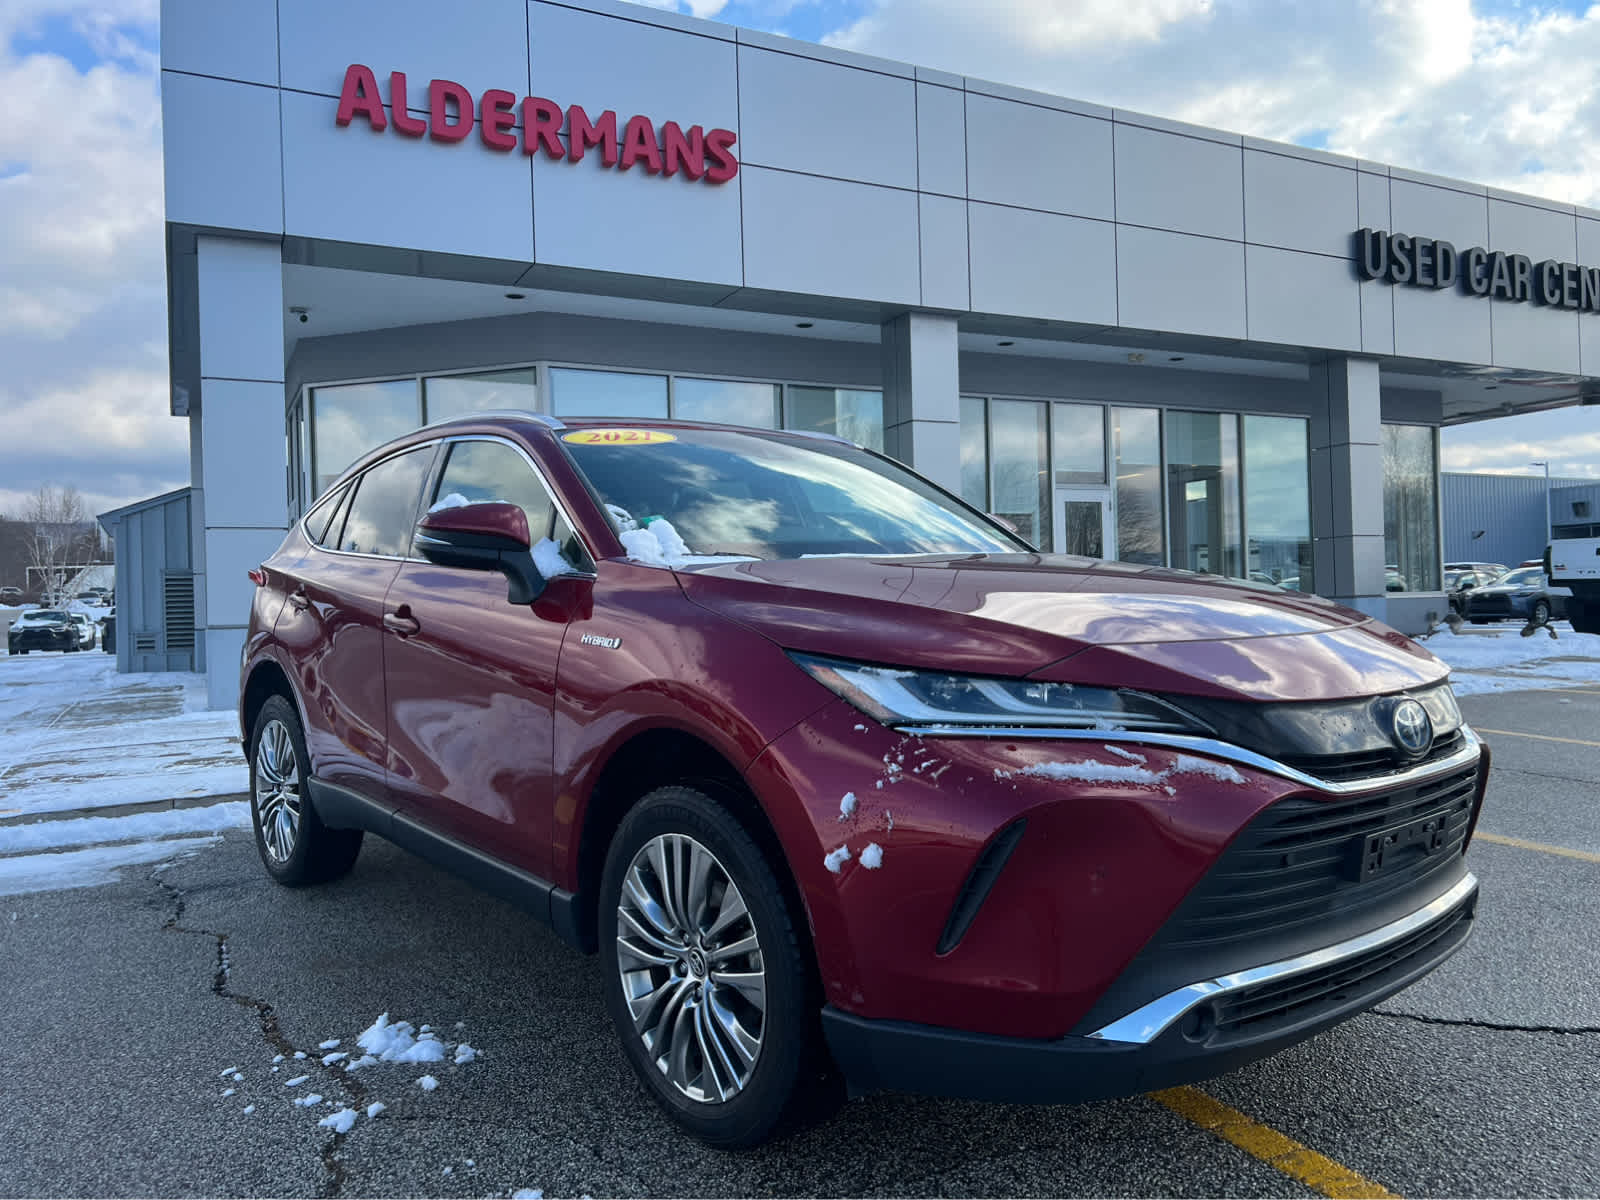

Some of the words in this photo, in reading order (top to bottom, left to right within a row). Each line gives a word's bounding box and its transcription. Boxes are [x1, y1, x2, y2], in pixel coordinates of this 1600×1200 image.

[336, 64, 738, 184] ALDERMANS
[1358, 228, 1457, 289] USED
[1464, 246, 1533, 301] CAR
[1538, 258, 1600, 312] CEN
[586, 431, 651, 442] 2021
[581, 634, 615, 648] HYBRID
